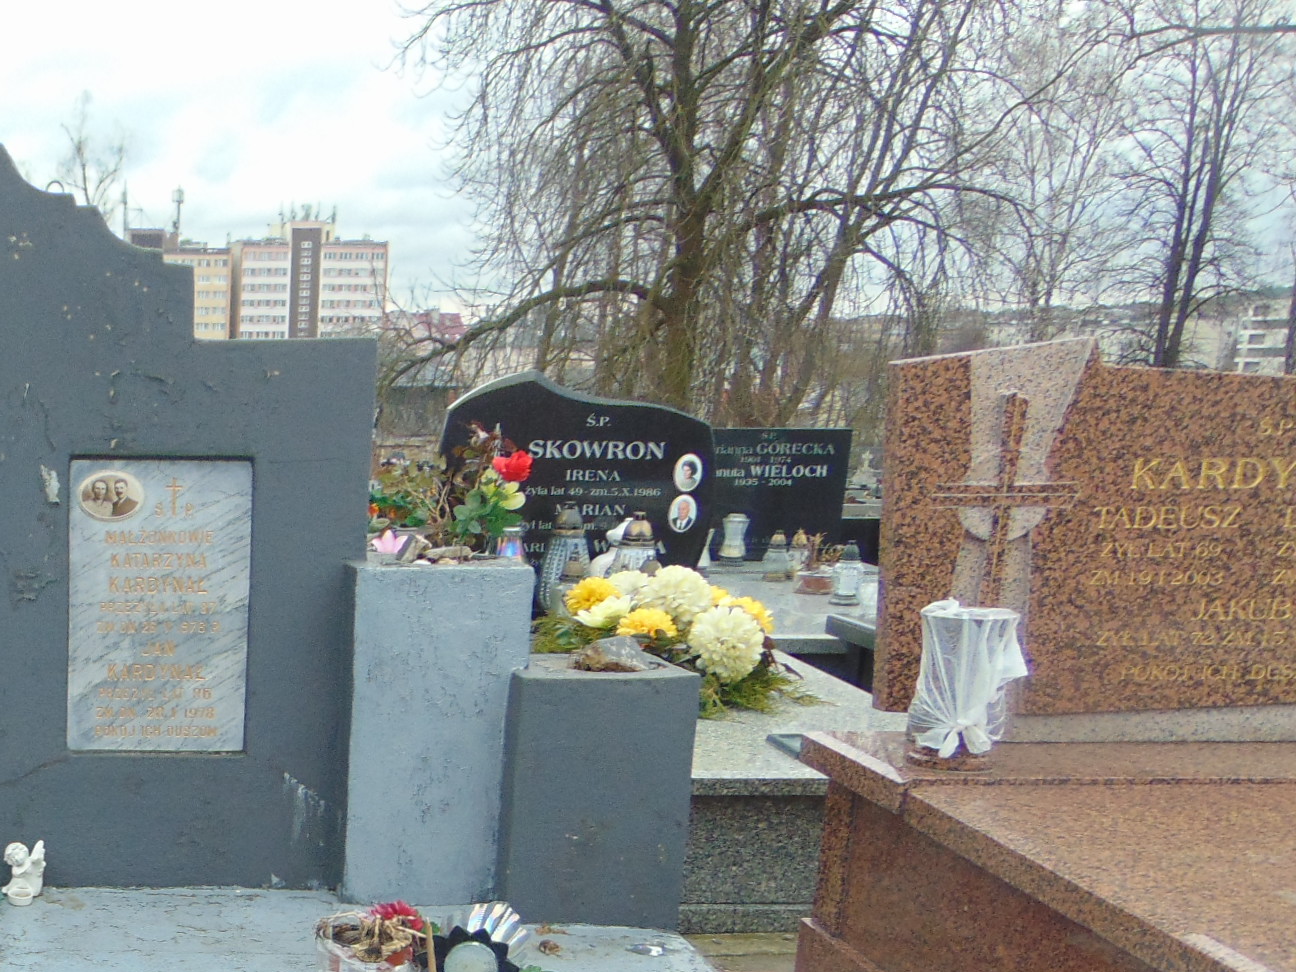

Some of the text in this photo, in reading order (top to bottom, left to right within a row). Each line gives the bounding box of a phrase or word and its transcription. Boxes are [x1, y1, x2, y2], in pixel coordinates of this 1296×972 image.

[528, 439, 666, 460] SKOWRON
[756, 440, 835, 455] GÓRECKA
[565, 469, 621, 482] IRENA
[750, 464, 827, 478] WIELOCH
[525, 486, 548, 496] żyła
[551, 486, 565, 496] lat
[554, 503, 625, 516] MRIAN
[1094, 506, 1244, 529] TADEUSZ
[1147, 542, 1187, 557] LAT
[1195, 542, 1222, 557] 69
[111, 552, 207, 569] KATARZYNA
[109, 576, 208, 594] KARDYNAŁ
[1171, 571, 1224, 585] 2003
[1190, 599, 1293, 620] JAKUB
[141, 640, 176, 657] JAN
[107, 663, 208, 681] KARDYNAŁ
[141, 725, 160, 738] ICH
